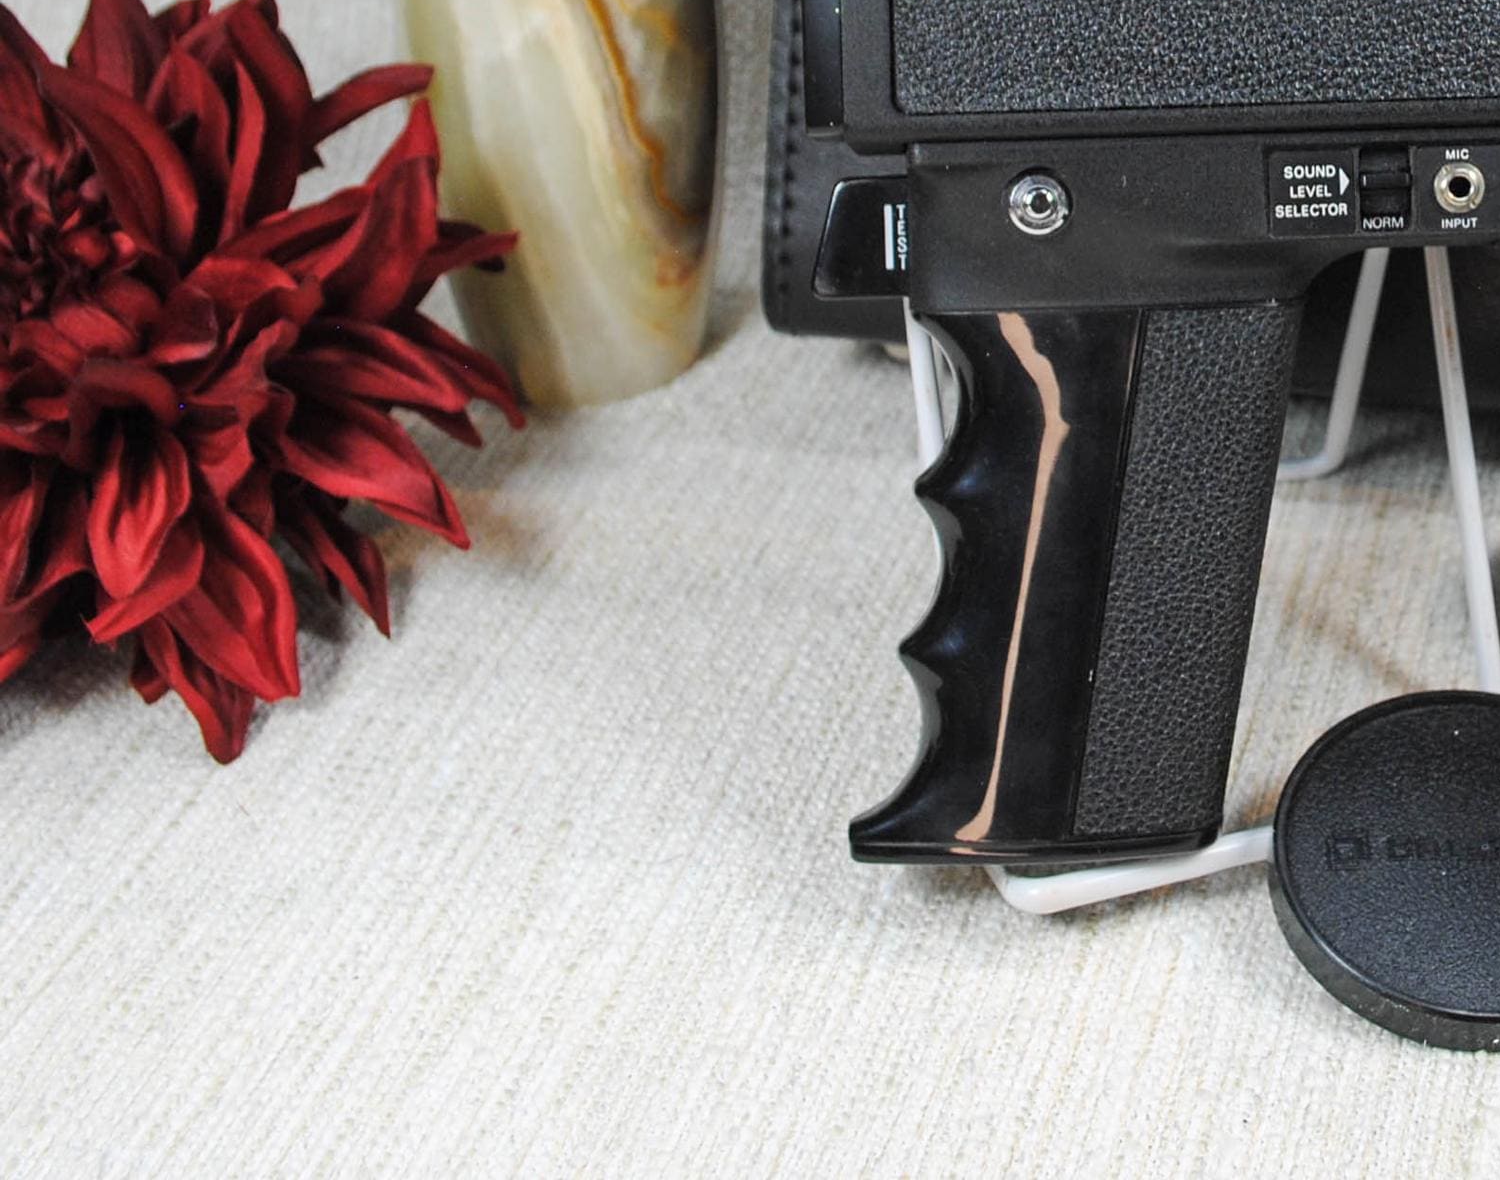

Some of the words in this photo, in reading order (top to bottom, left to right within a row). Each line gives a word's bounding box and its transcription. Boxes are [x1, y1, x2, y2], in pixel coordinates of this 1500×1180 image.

[1445, 148, 1470, 160] MIC
[1283, 165, 1336, 179] SOUND
[1289, 184, 1332, 199] LEVEL
[1275, 203, 1349, 219] SELECTOR
[1362, 216, 1405, 230] NORM
[1441, 217, 1479, 230] INPUT
[895, 203, 909, 270] TEST
